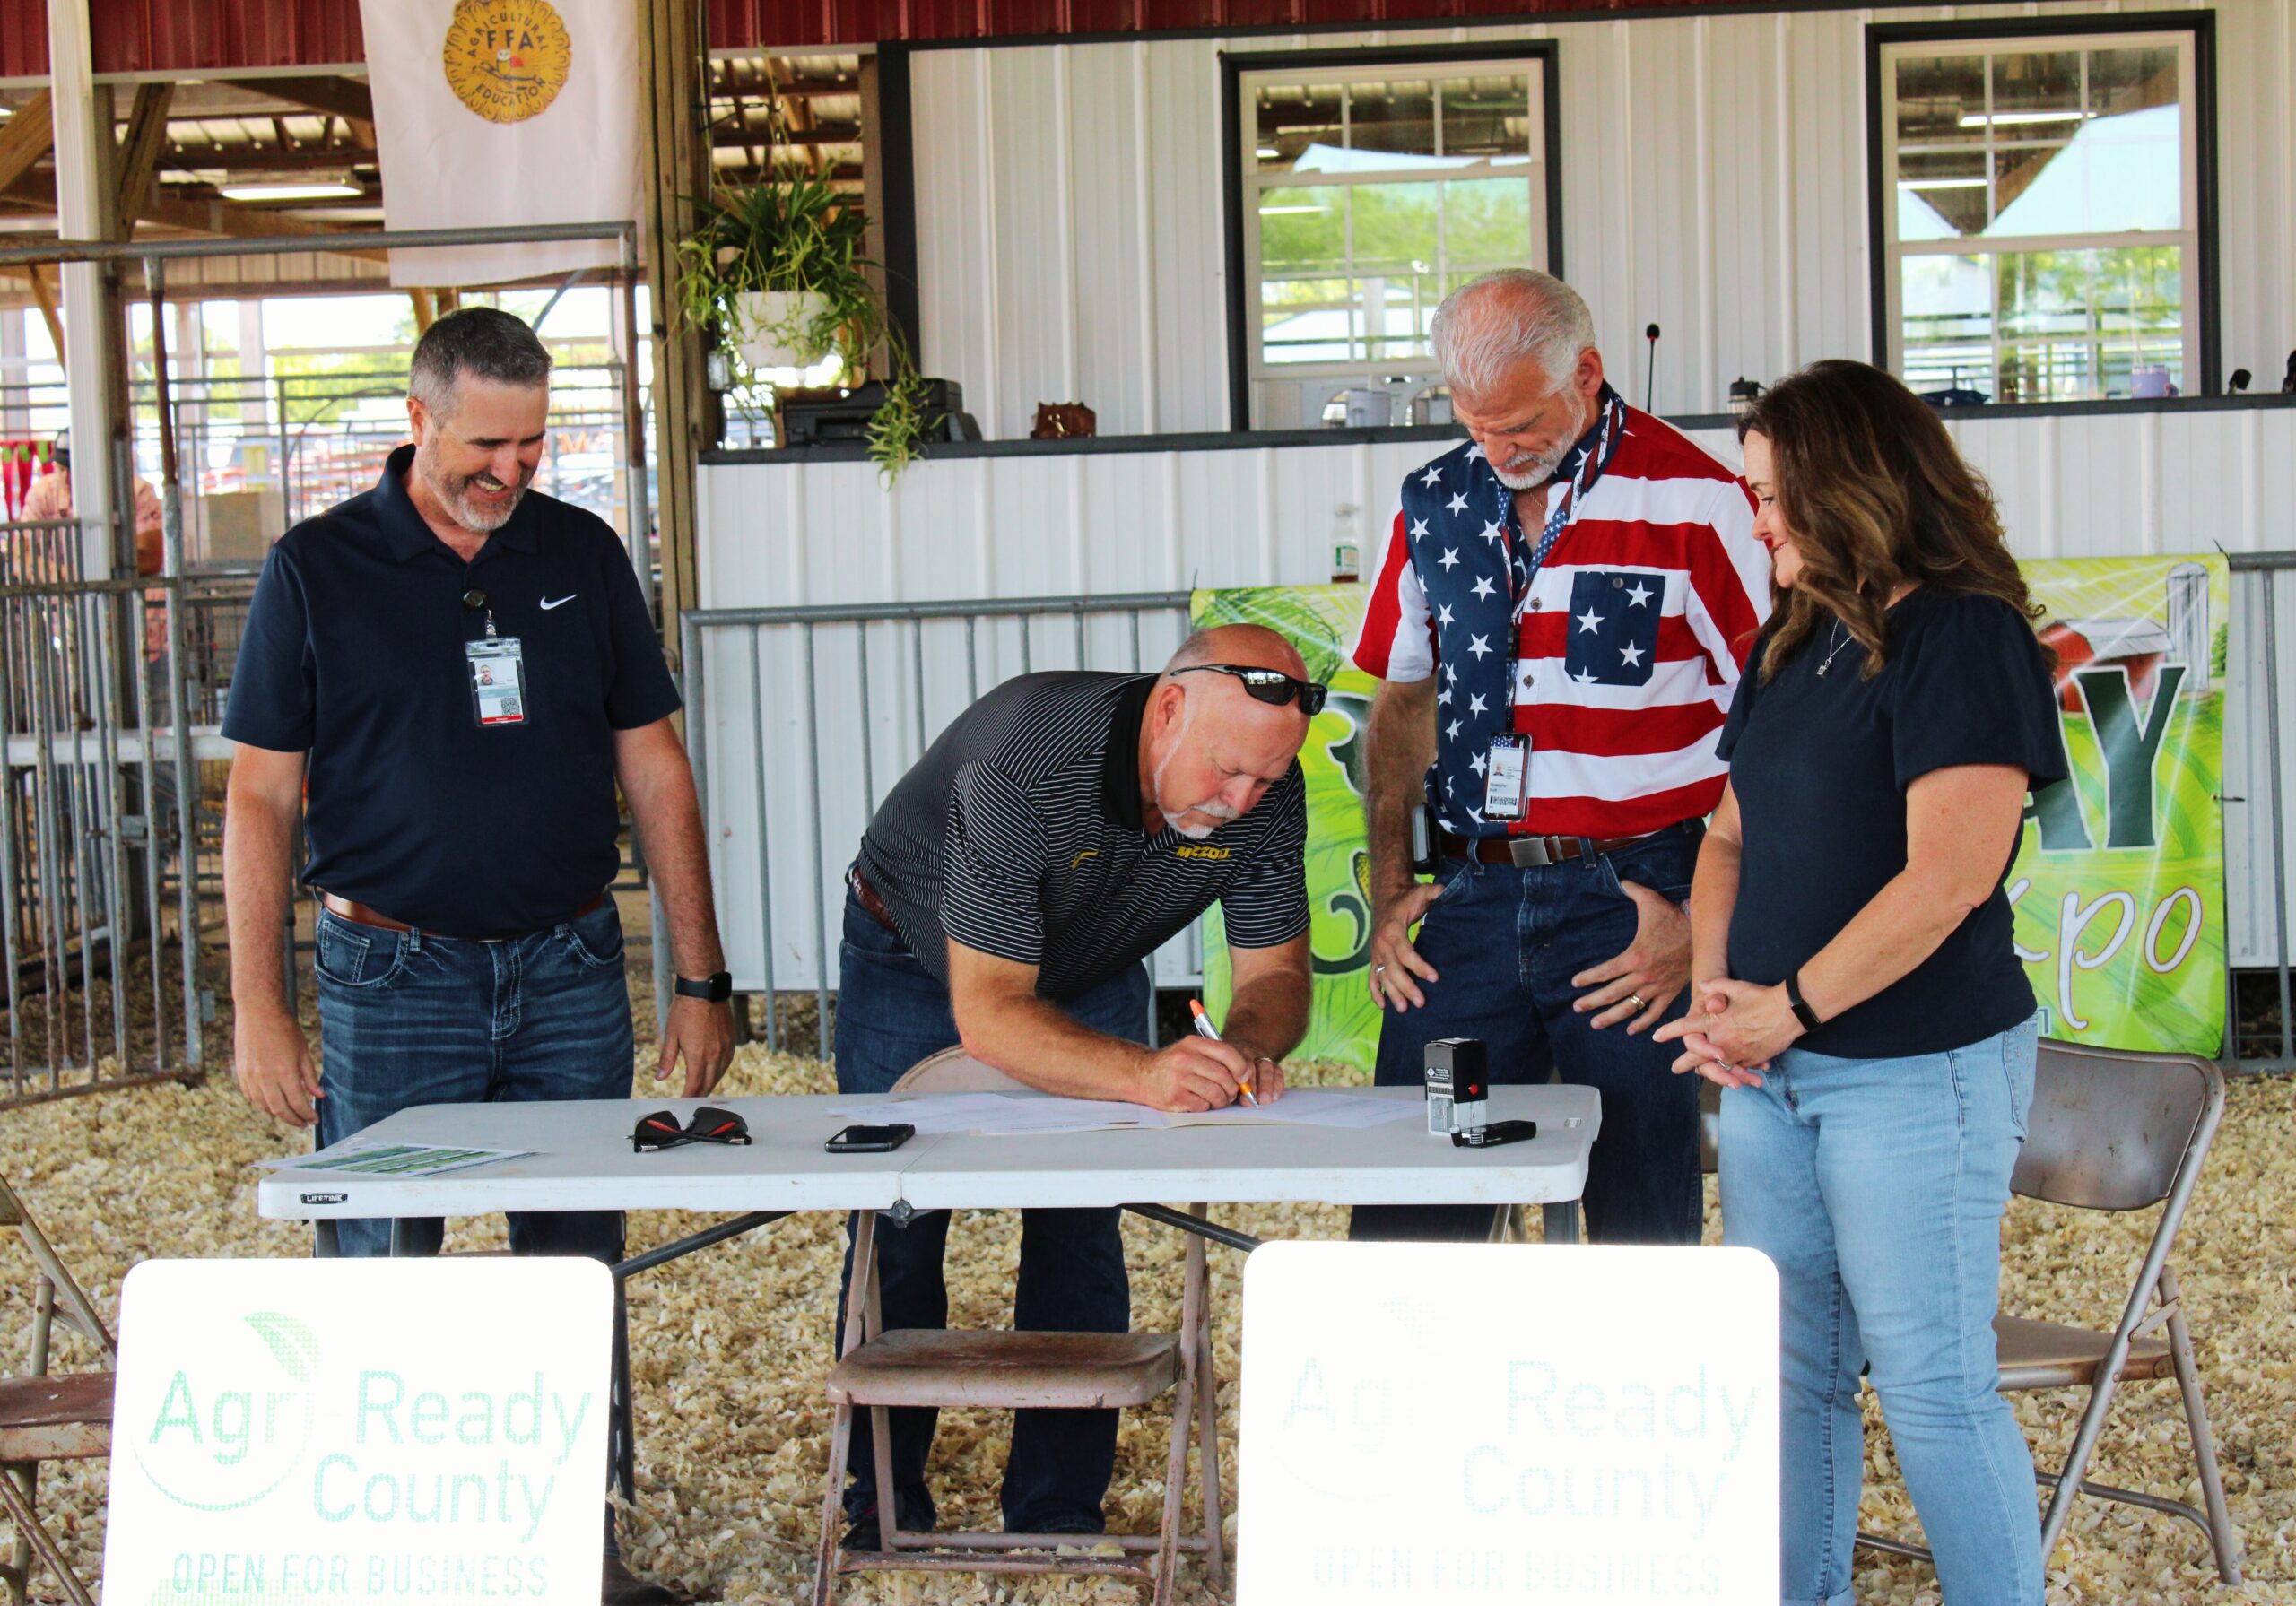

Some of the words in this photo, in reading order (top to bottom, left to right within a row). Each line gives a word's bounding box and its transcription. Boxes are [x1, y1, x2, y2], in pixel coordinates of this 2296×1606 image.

[466, 12, 548, 57] AGRICULTURAL
[487, 30, 534, 50] FFA
[475, 79, 545, 107] EDUCATION
[356, 1369, 592, 1465] Ready
[1507, 1358, 1762, 1462] Ready
[313, 1452, 555, 1543] County
[1463, 1442, 1729, 1541] County
[172, 1553, 265, 1595] OPEN
[282, 1553, 350, 1596] FOR
[366, 1553, 548, 1597] BUSINESS
